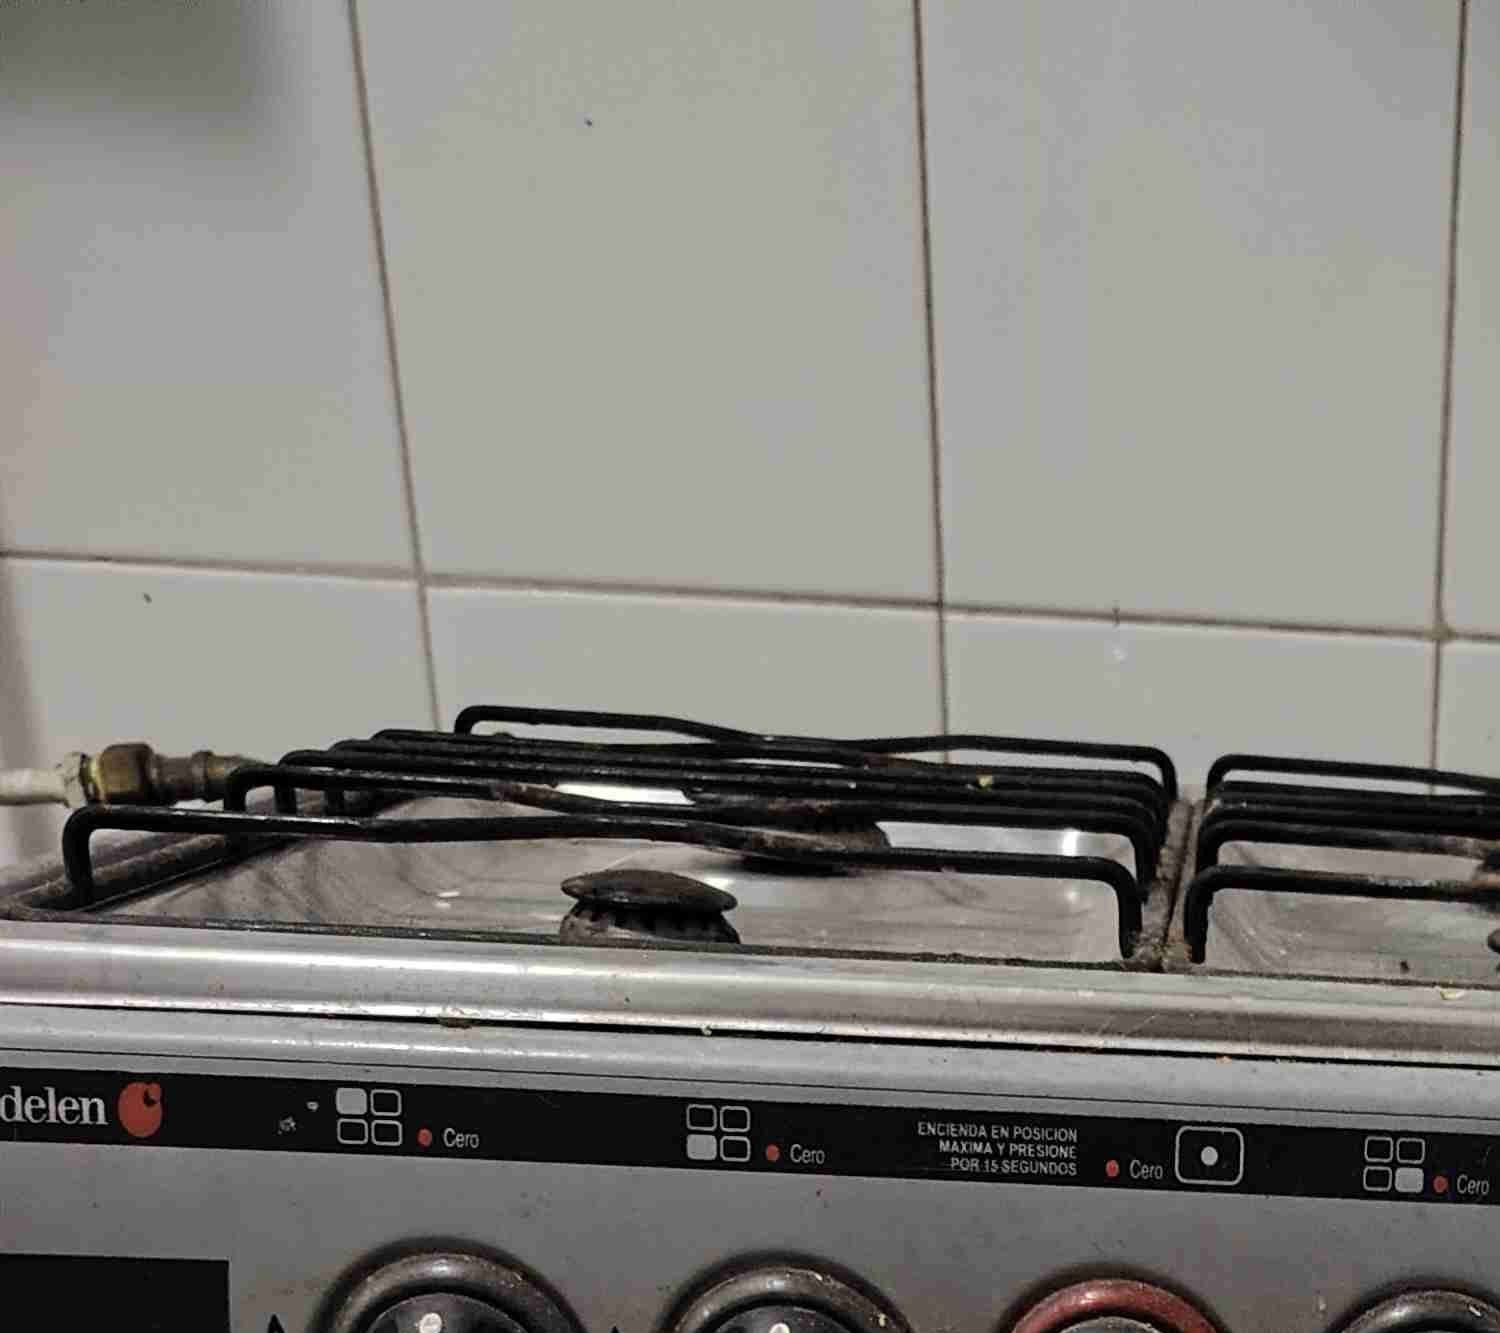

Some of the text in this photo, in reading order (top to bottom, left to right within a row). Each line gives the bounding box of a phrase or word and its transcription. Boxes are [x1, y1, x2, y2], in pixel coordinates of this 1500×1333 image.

[442, 1126, 480, 1149] Cero
[917, 1121, 1078, 1143] ENCIENDA EN POSICION
[790, 1144, 826, 1165] Cero
[939, 1139, 1077, 1160] MAXIMA Y PRESIONE
[951, 1157, 1078, 1176] POR 15 SEGUNDOS
[1129, 1160, 1164, 1181] Cero
[1456, 1174, 1490, 1196] Cero
